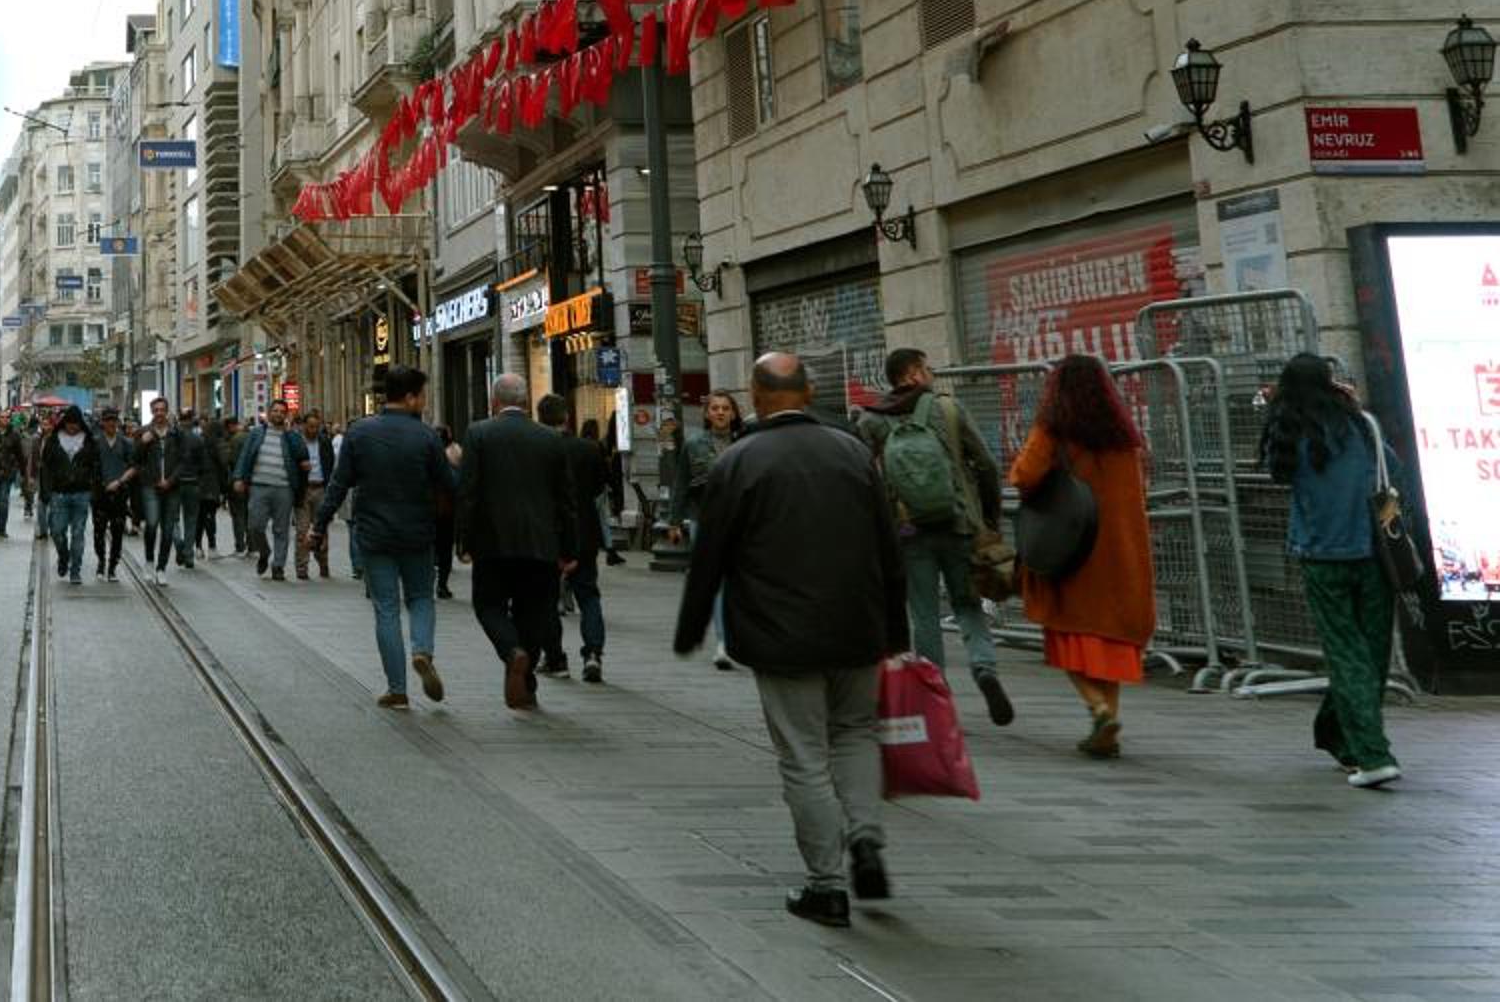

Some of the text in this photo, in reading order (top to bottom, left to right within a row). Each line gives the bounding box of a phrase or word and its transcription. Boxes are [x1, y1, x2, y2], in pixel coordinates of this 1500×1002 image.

[1311, 111, 1349, 129] EMİR
[1312, 133, 1376, 147] NEVRUZ
[1419, 426, 1500, 449] 1. TAK
